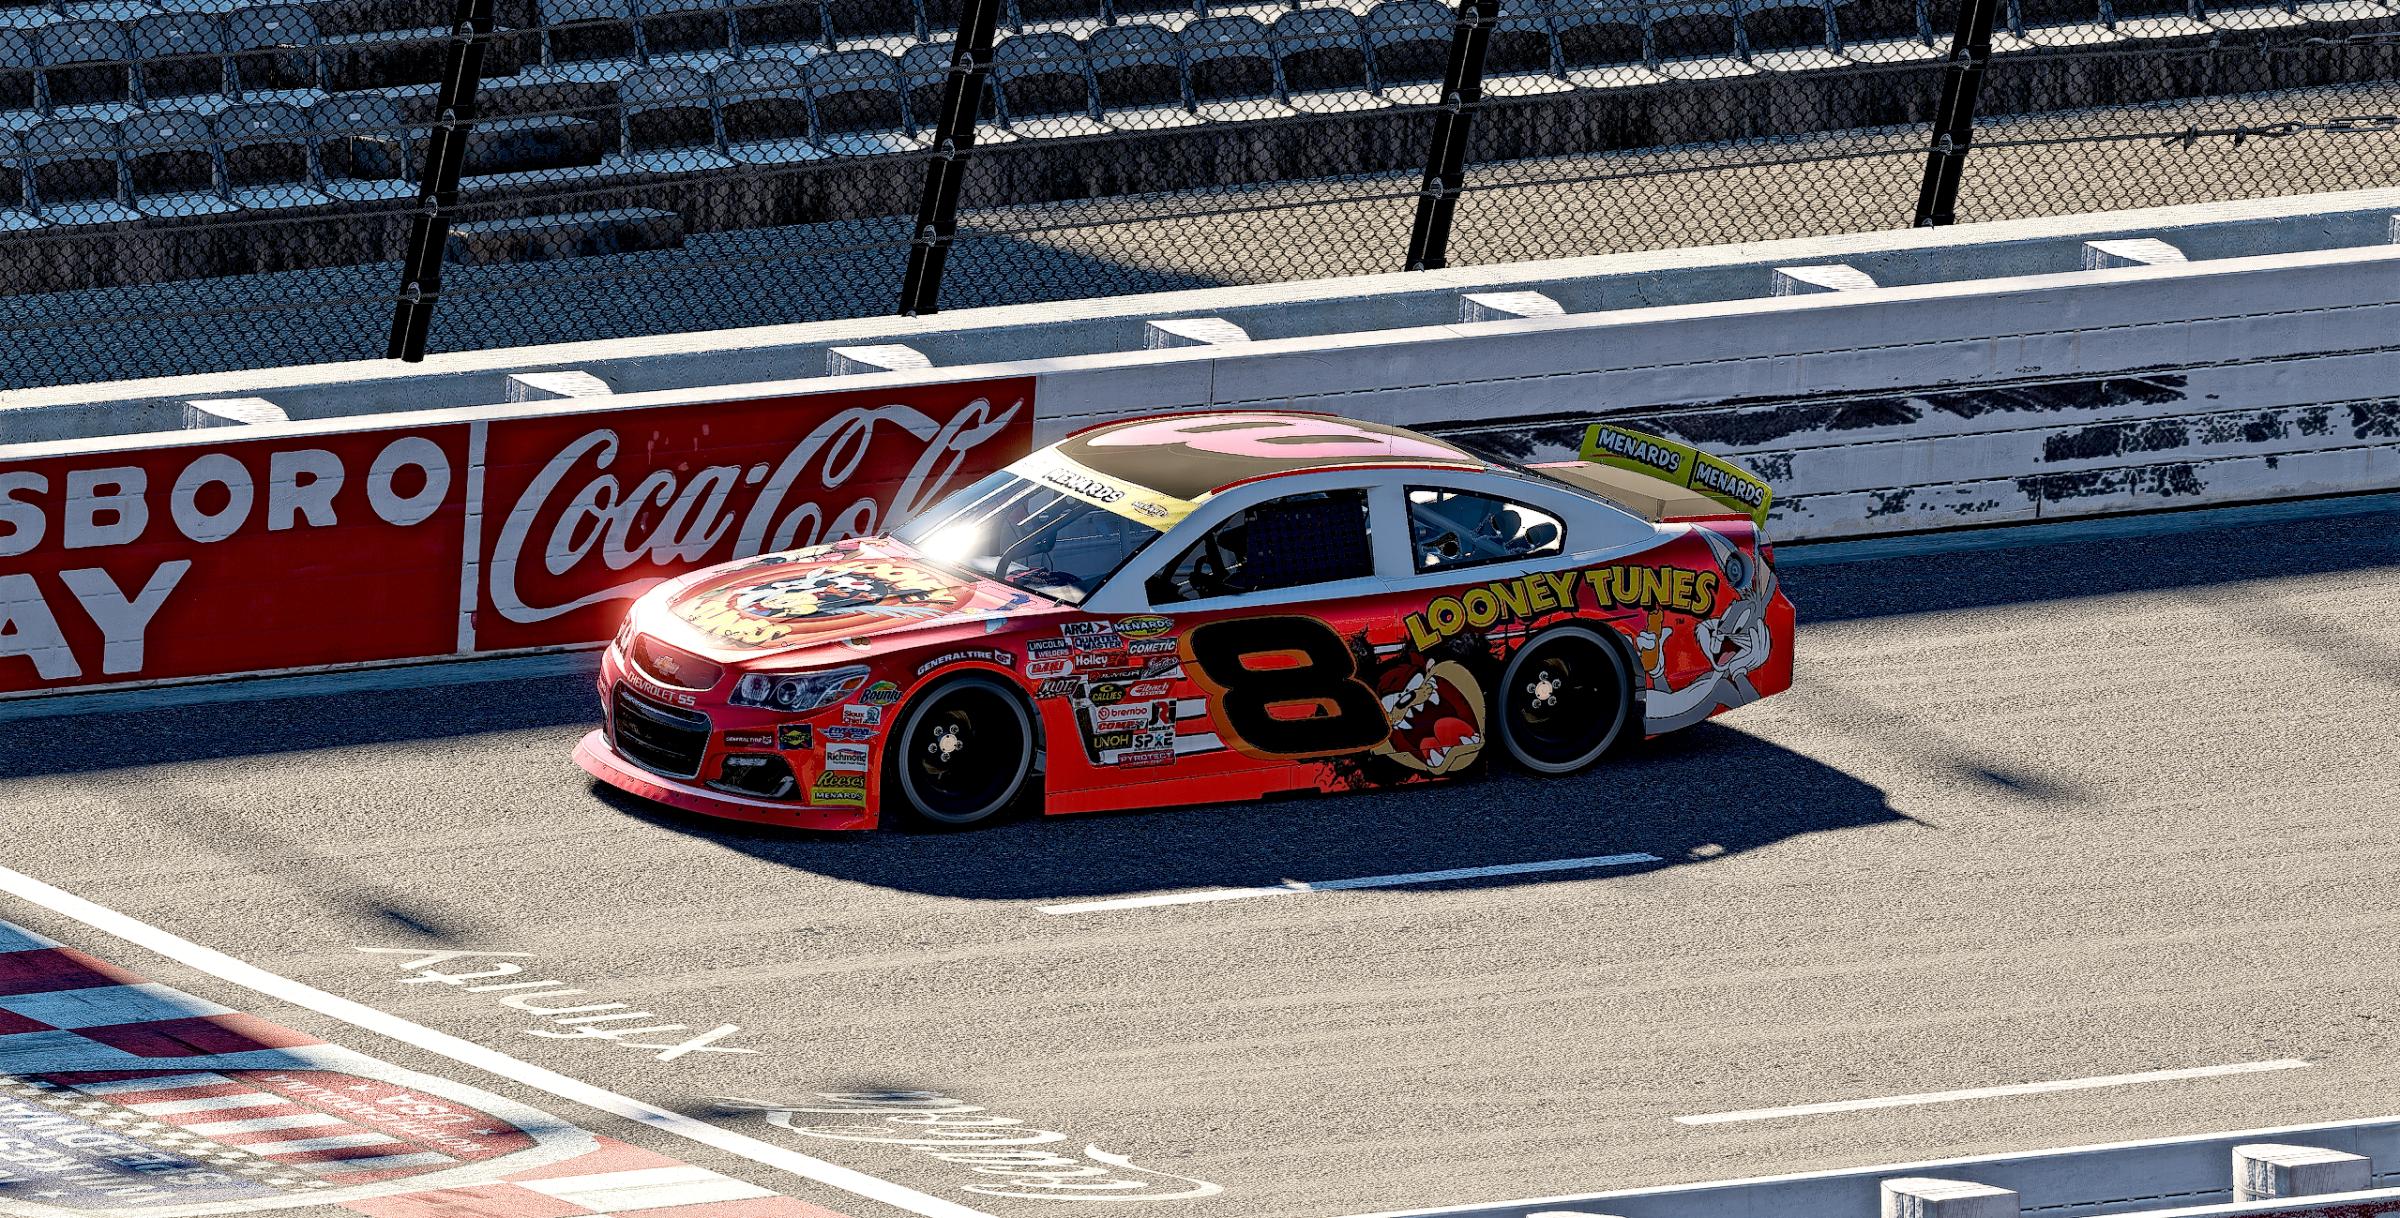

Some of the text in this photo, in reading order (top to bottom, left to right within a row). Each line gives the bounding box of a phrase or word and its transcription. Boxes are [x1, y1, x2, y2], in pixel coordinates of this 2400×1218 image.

[1597, 428, 1680, 472] MENARDS
[1695, 462, 1765, 508] MENARDS
[0, 436, 451, 557] SBORO
[489, 397, 1023, 623] Coca-Col
[1405, 565, 1720, 652] LOONEY TUNES
[1064, 623, 1095, 635] ARCA
[1112, 619, 1175, 632] MENARDS
[1029, 640, 1065, 650] LINCOLN
[1130, 641, 1176, 654] COMETIC
[1038, 649, 1069, 657] WELDERS
[1075, 654, 1108, 667] Holley
[627, 671, 676, 701] CHEVROLET
[678, 694, 696, 706] SS
[1041, 680, 1078, 692] KLOTZ
[1180, 615, 1393, 760] 8
[1092, 690, 1123, 702] CALLIES
[1111, 706, 1148, 717] brembo
[1094, 735, 1130, 748] UNOH
[827, 751, 867, 762] Richmond
[815, 792, 863, 801] MENARDS
